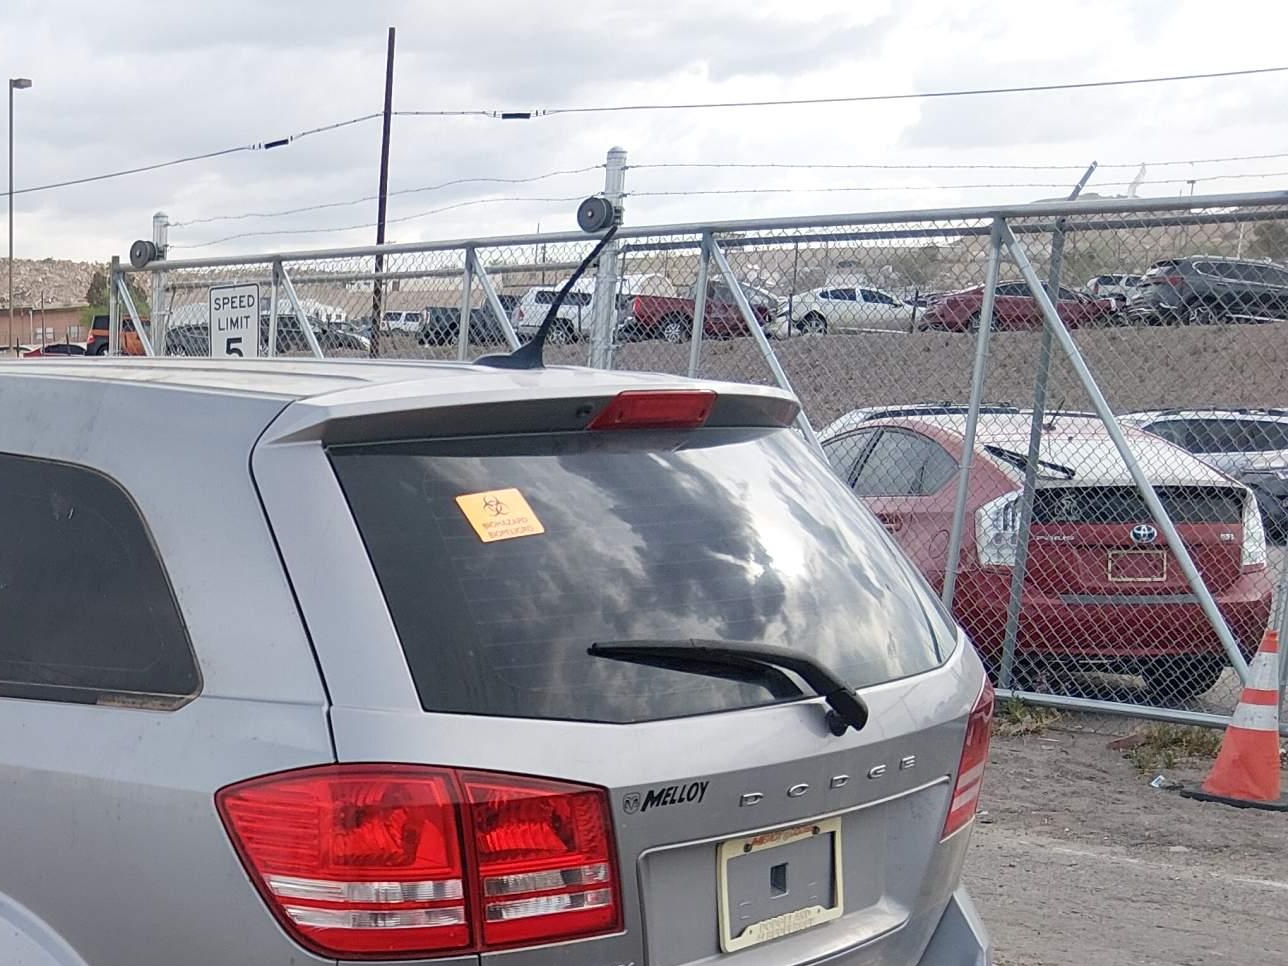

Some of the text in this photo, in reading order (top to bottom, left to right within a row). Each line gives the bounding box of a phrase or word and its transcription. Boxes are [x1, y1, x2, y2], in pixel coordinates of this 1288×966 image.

[214, 294, 255, 311] SPEED
[218, 315, 250, 331] LIMIT
[226, 337, 244, 357] 5
[738, 754, 917, 808] DODGE
[640, 781, 710, 812] MELLOY
